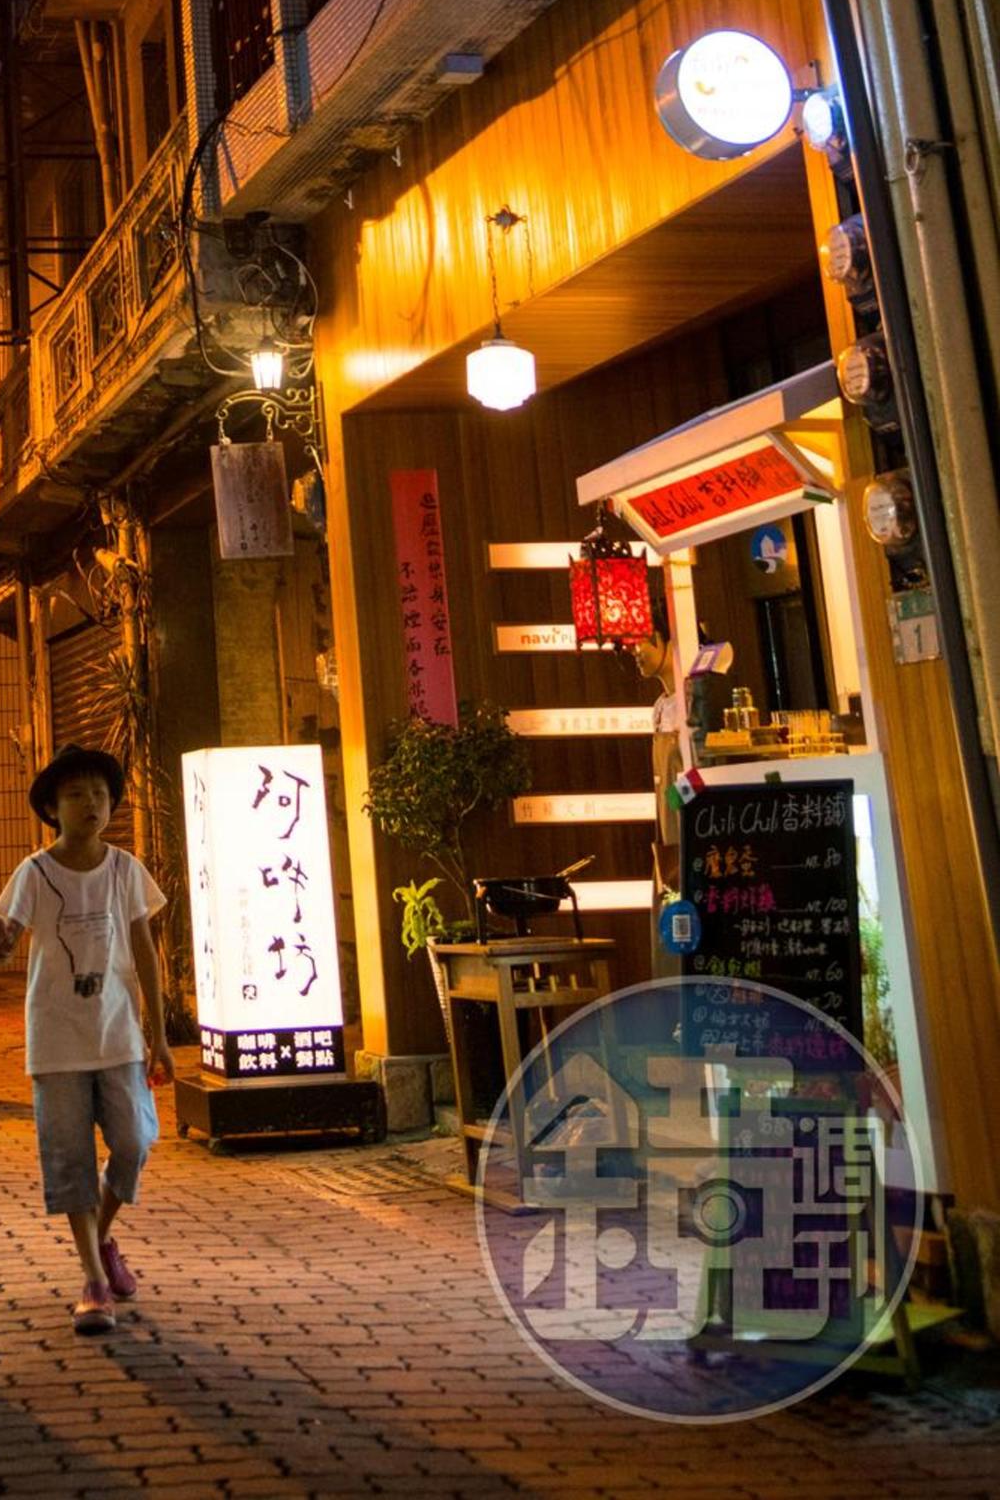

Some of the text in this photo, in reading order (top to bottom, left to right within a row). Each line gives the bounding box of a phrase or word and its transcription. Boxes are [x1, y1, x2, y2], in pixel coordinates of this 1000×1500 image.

[237, 1032, 277, 1050] 咖啡
[294, 1030, 333, 1048] 酒吧
[238, 1052, 278, 1070] 飲料
